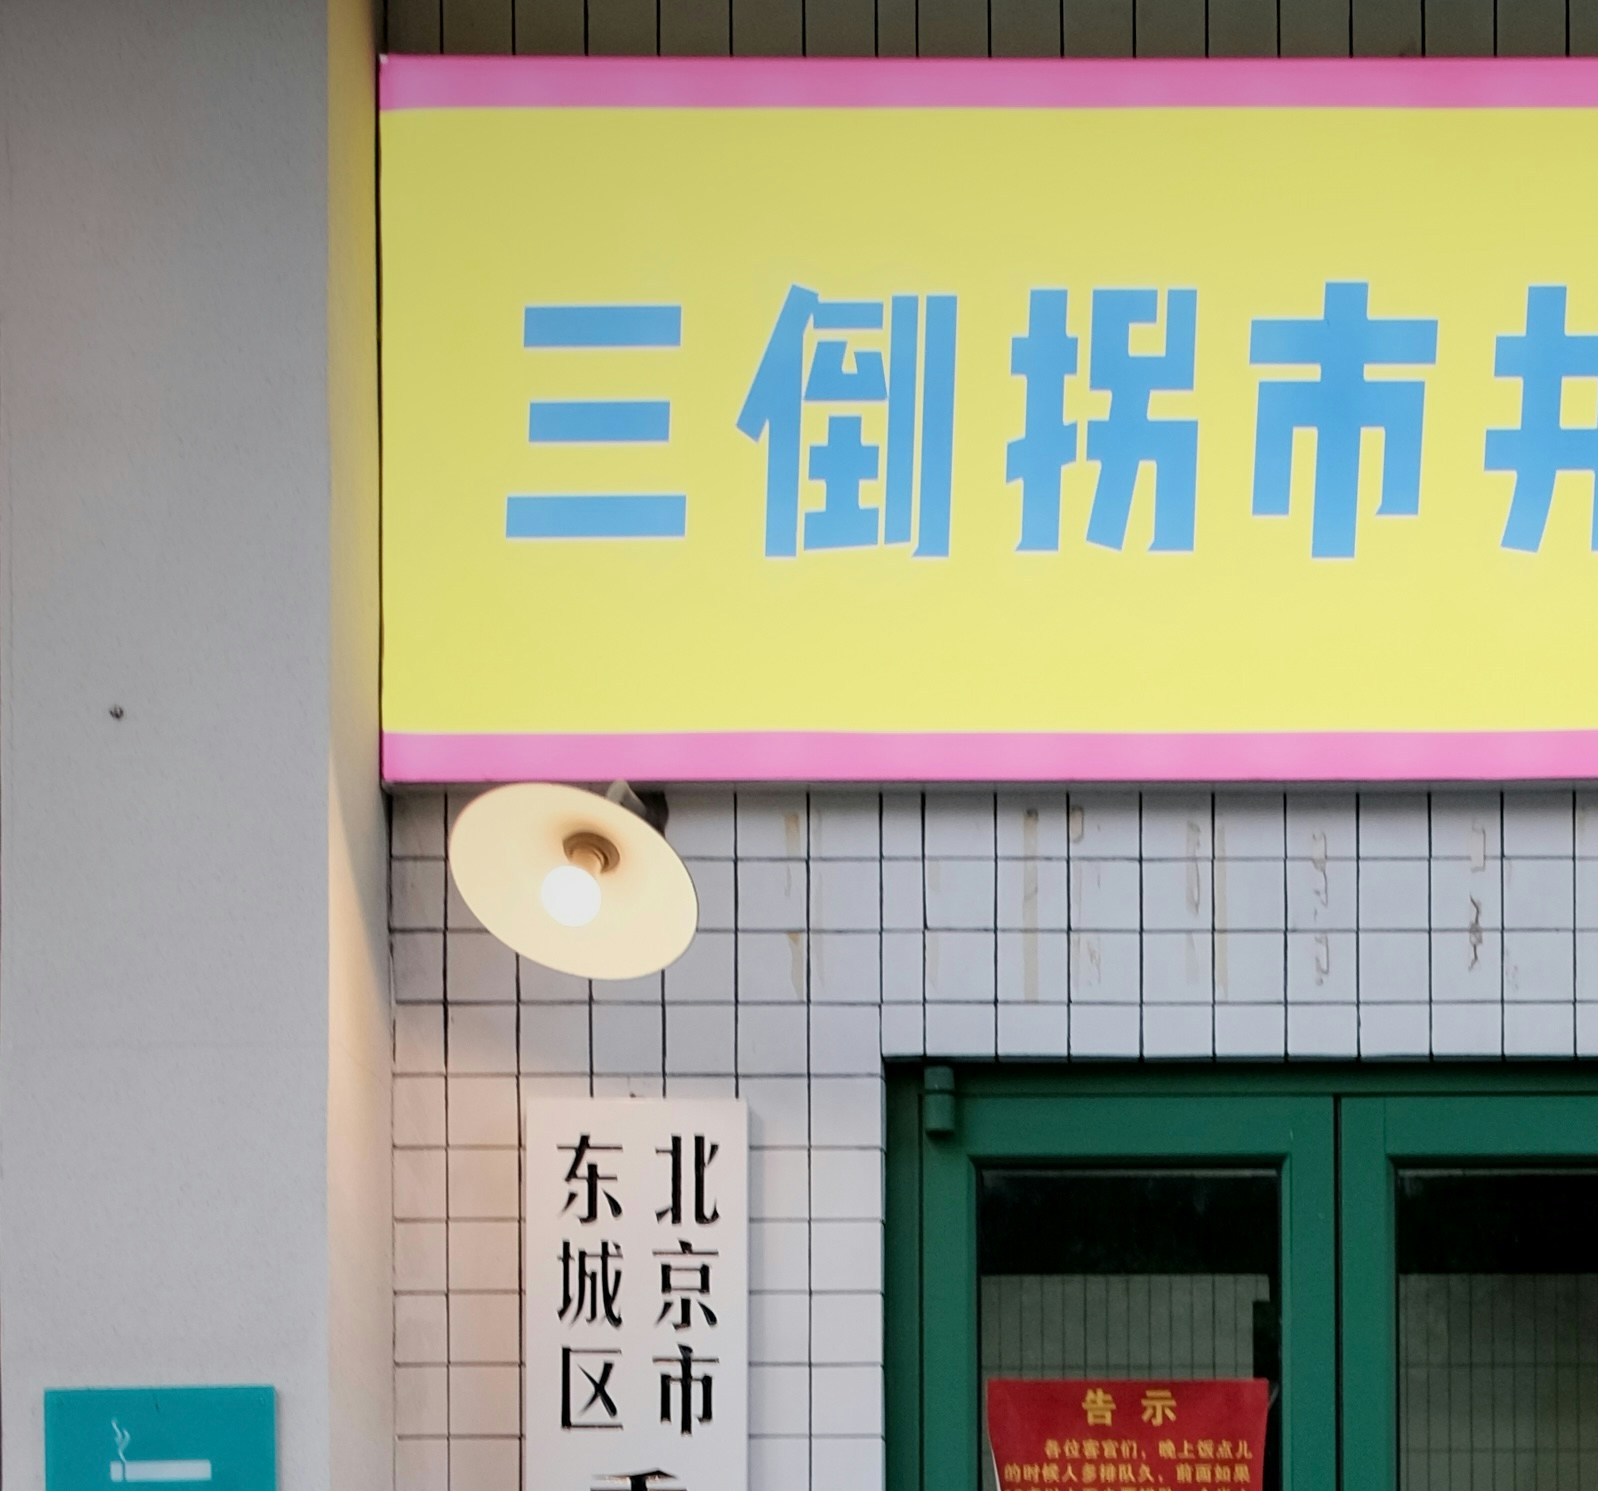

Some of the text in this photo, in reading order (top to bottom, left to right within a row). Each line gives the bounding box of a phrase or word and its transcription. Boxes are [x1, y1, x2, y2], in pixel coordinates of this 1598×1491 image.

[556, 1133, 624, 1431] 东城区
[653, 1133, 720, 1436] 北京市
[1081, 1388, 1177, 1427] 告示
